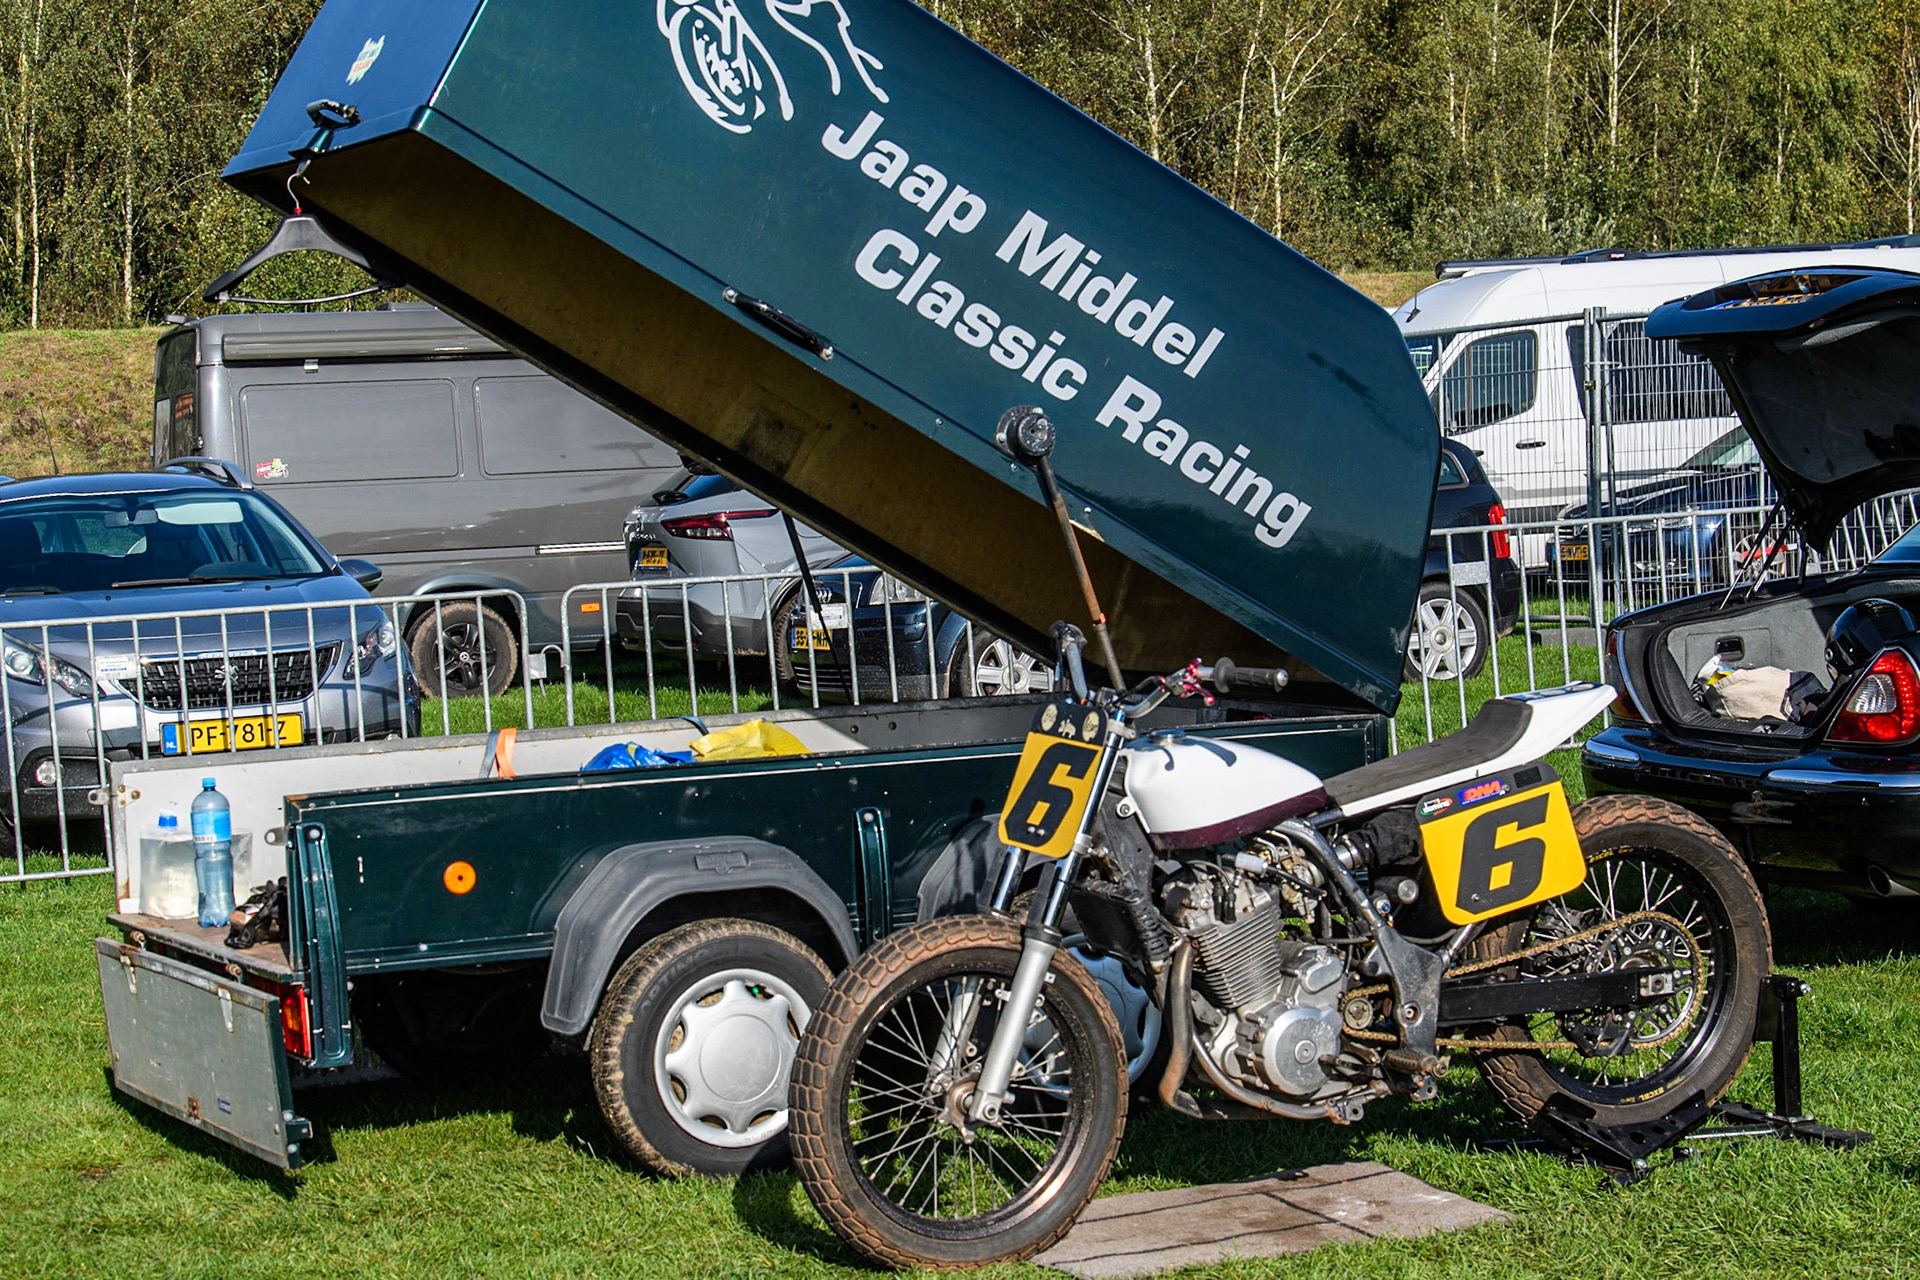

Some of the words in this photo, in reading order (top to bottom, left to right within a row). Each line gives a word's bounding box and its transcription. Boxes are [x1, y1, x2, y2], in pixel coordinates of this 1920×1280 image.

[821, 110, 987, 238] Jaap
[995, 209, 1226, 379] Middel
[854, 228, 1088, 401] Classic
[1095, 374, 1312, 549] Racing
[1004, 742, 1099, 847] 6
[1456, 792, 1550, 915] 6
